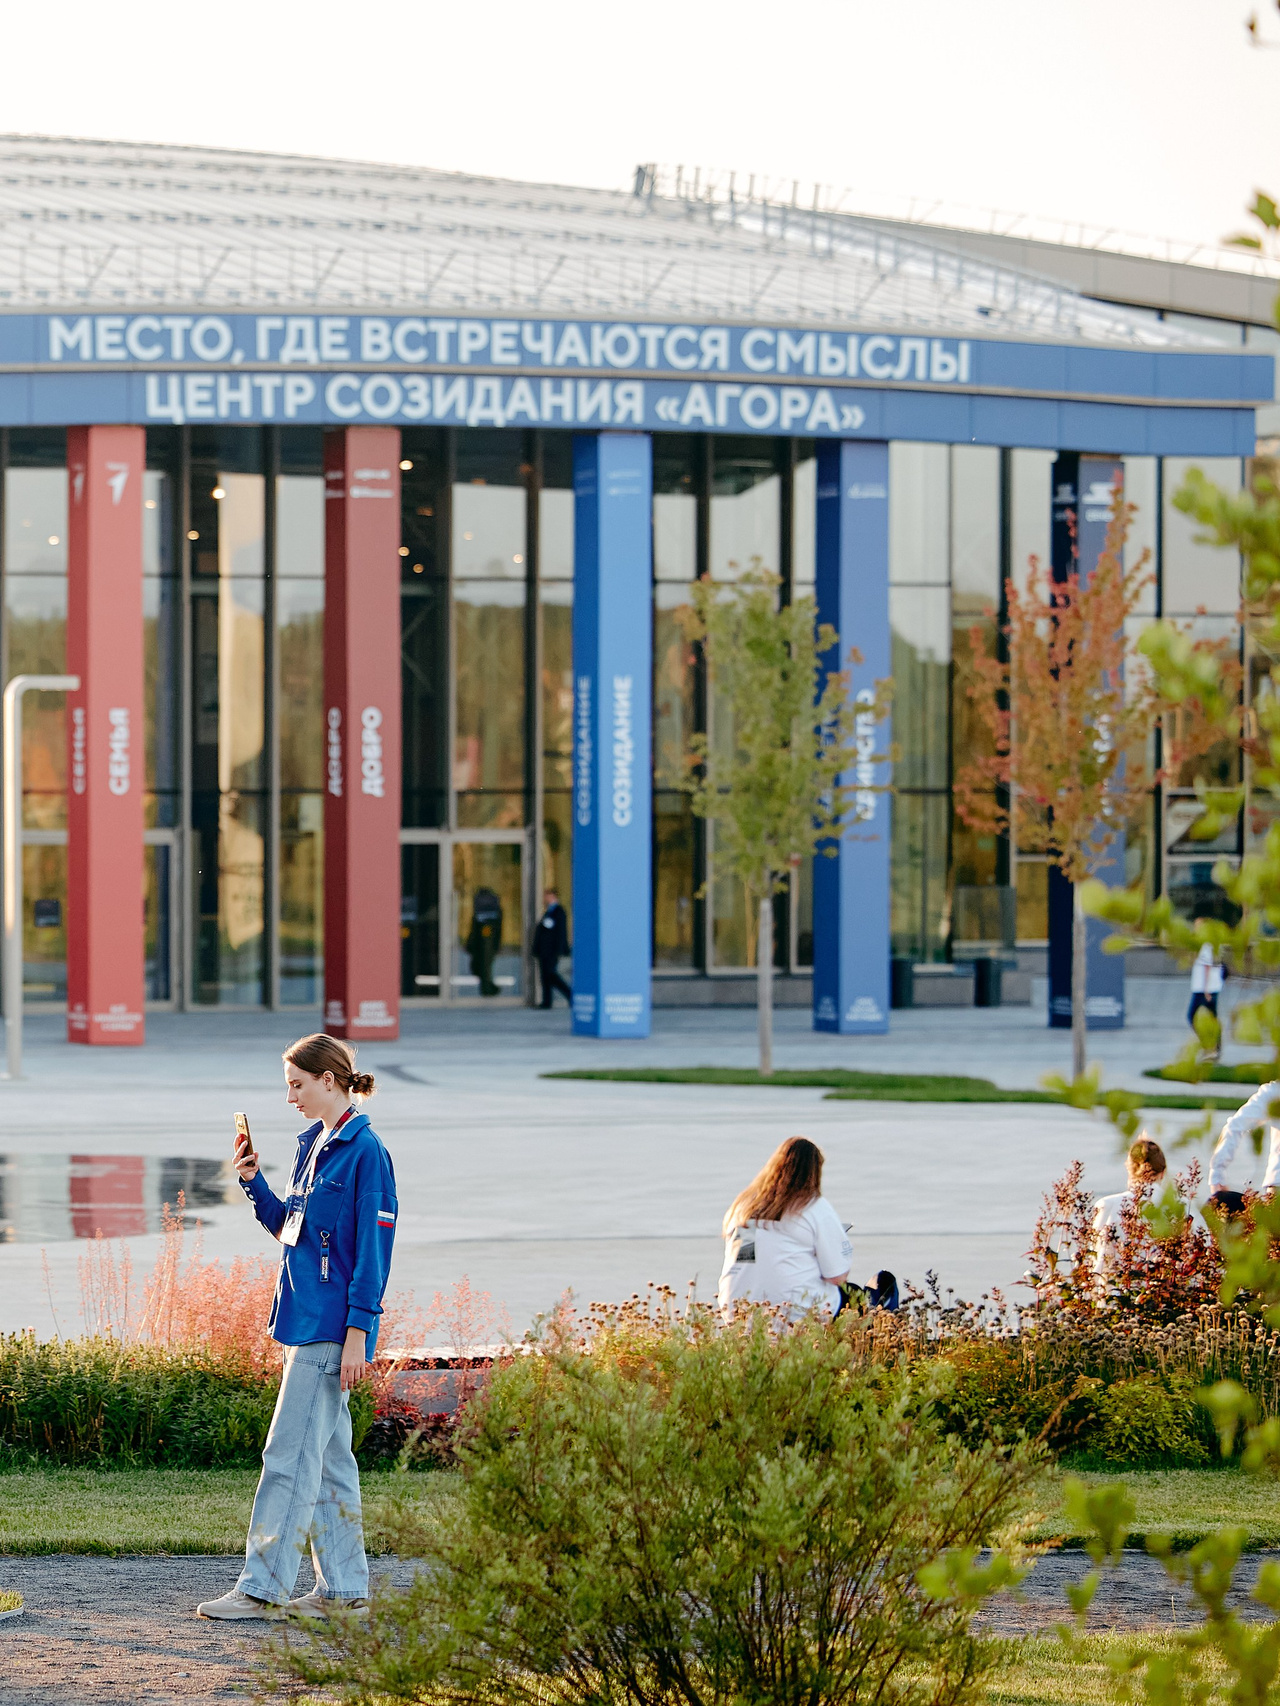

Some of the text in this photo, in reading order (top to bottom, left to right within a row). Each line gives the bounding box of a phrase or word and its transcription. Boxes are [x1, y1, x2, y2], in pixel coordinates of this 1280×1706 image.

[47, 315, 970, 383] МЕСТО, ГДЕ ВСТРЕЧАЮТСЯ СМЫСЛЫ
[144, 373, 866, 433] ЦЕНТР СОЗИДАНИЯ «АГОРА»
[108, 707, 130, 796] СЕМЬЯ
[361, 705, 385, 798] ДОБРО
[612, 673, 634, 828] СОЗИДАНИЕ
